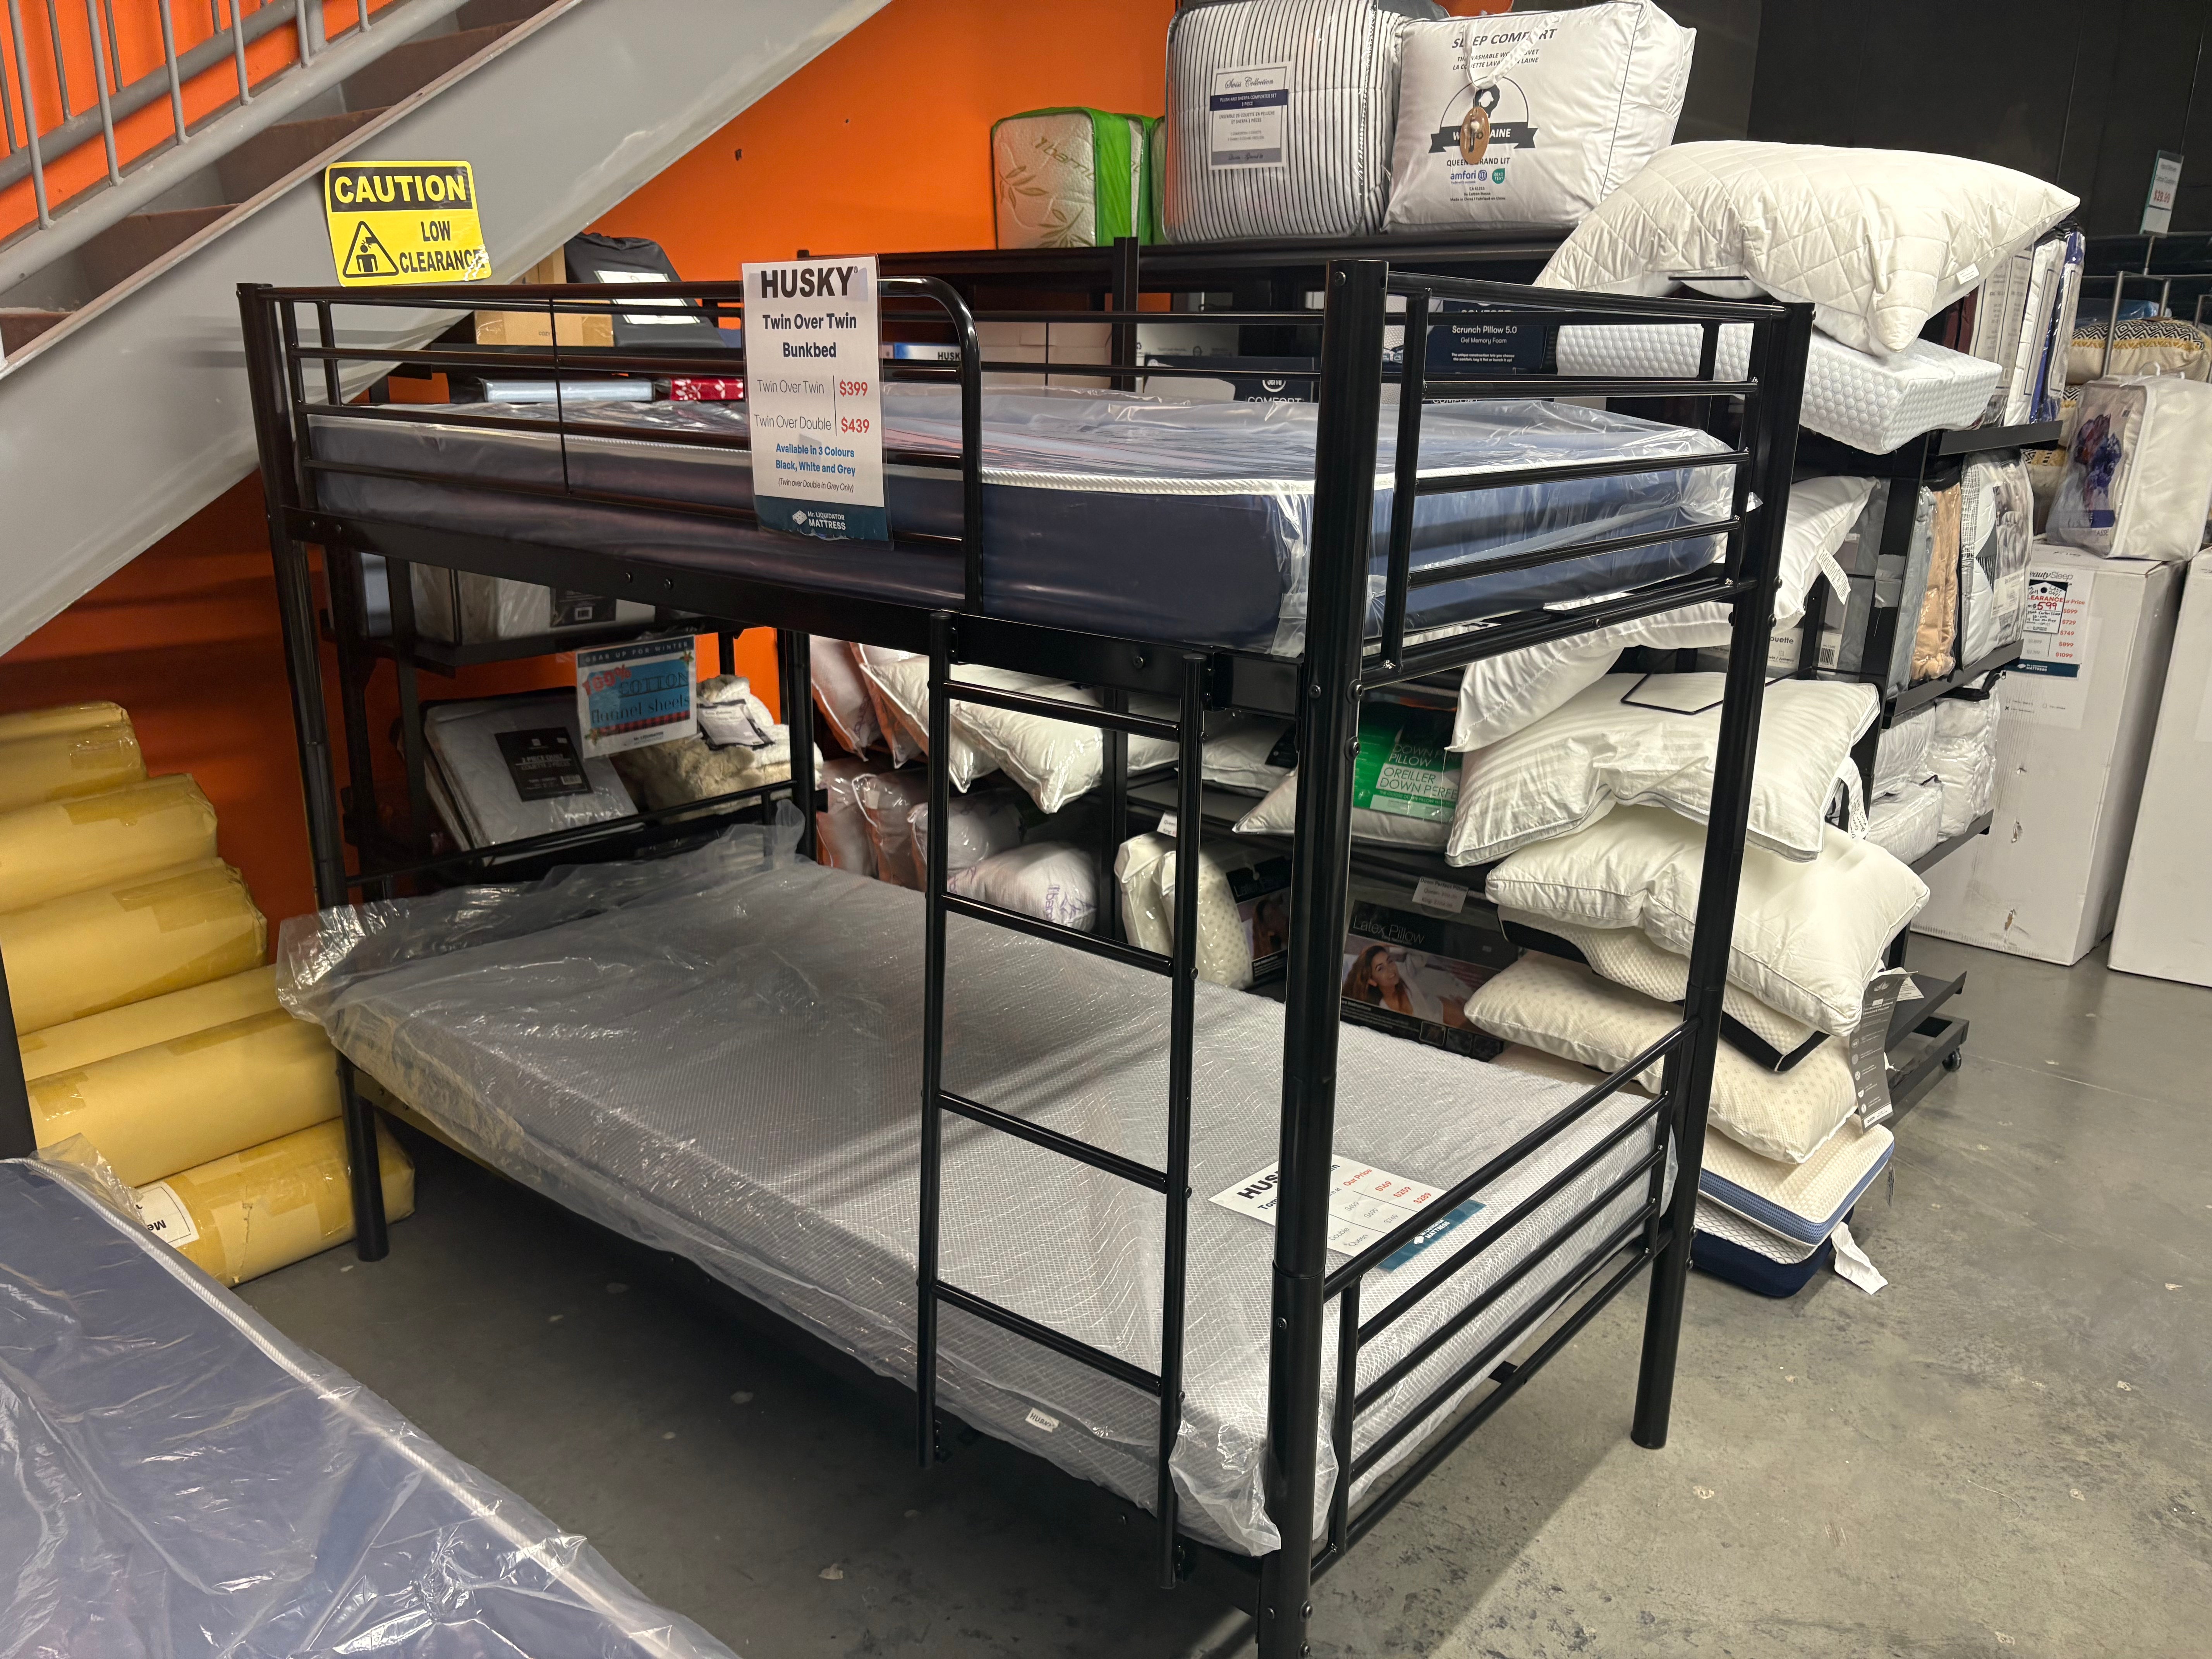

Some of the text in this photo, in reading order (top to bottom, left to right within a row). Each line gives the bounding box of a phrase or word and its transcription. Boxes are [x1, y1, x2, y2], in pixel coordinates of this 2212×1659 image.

[1452, 29, 1557, 48] SLEP COMFRT
[1490, 129, 1511, 138] AINE
[1450, 170, 1476, 180] amfori
[335, 175, 466, 203] CAUTION
[421, 220, 451, 242] LOW
[399, 249, 486, 273] CLEARANCE
[763, 312, 857, 330] Twin Over Twin
[1452, 325, 1481, 334] Scrunch
[1483, 325, 1504, 334] Pillow
[783, 342, 836, 358] Bunkbed
[938, 352, 960, 360] HUSK
[757, 379, 868, 397] Twin Over Twin $399
[754, 414, 869, 434] Twin Over Double $439
[776, 443, 854, 458] Available in 3 Colours
[776, 460, 855, 477] Black, White and Grey
[778, 477, 791, 487] (Twin
[803, 479, 820, 489] Double
[821, 481, 826, 489] in
[826, 482, 839, 492] Grey
[840, 483, 854, 493] Only)
[808, 519, 846, 530] MATTRESS
[816, 512, 845, 521] LIQUIDATOR
[655, 641, 688, 652] WINTER
[582, 664, 632, 697] 100%
[619, 671, 689, 696] COTTON
[649, 694, 689, 714] sheets
[1394, 744, 1433, 757] DOWN
[1389, 753, 1432, 767] PILLOW
[1384, 767, 1436, 784] OREILLER
[1380, 778, 1458, 800] DOWN PERFE
[1353, 915, 1386, 937] Latex
[1388, 924, 1425, 944] Pillow
[1236, 1171, 1278, 1199] HUS
[1343, 1169, 1372, 1186] Our Price
[1375, 1181, 1392, 1192] $169
[1393, 1186, 1412, 1198] $259
[1413, 1192, 1432, 1204] $289
[1364, 1208, 1379, 1218] $699
[1328, 1227, 1350, 1241] Double
[1424, 1221, 1451, 1239] MATTRESS
[1348, 1234, 1369, 1247] Queen
